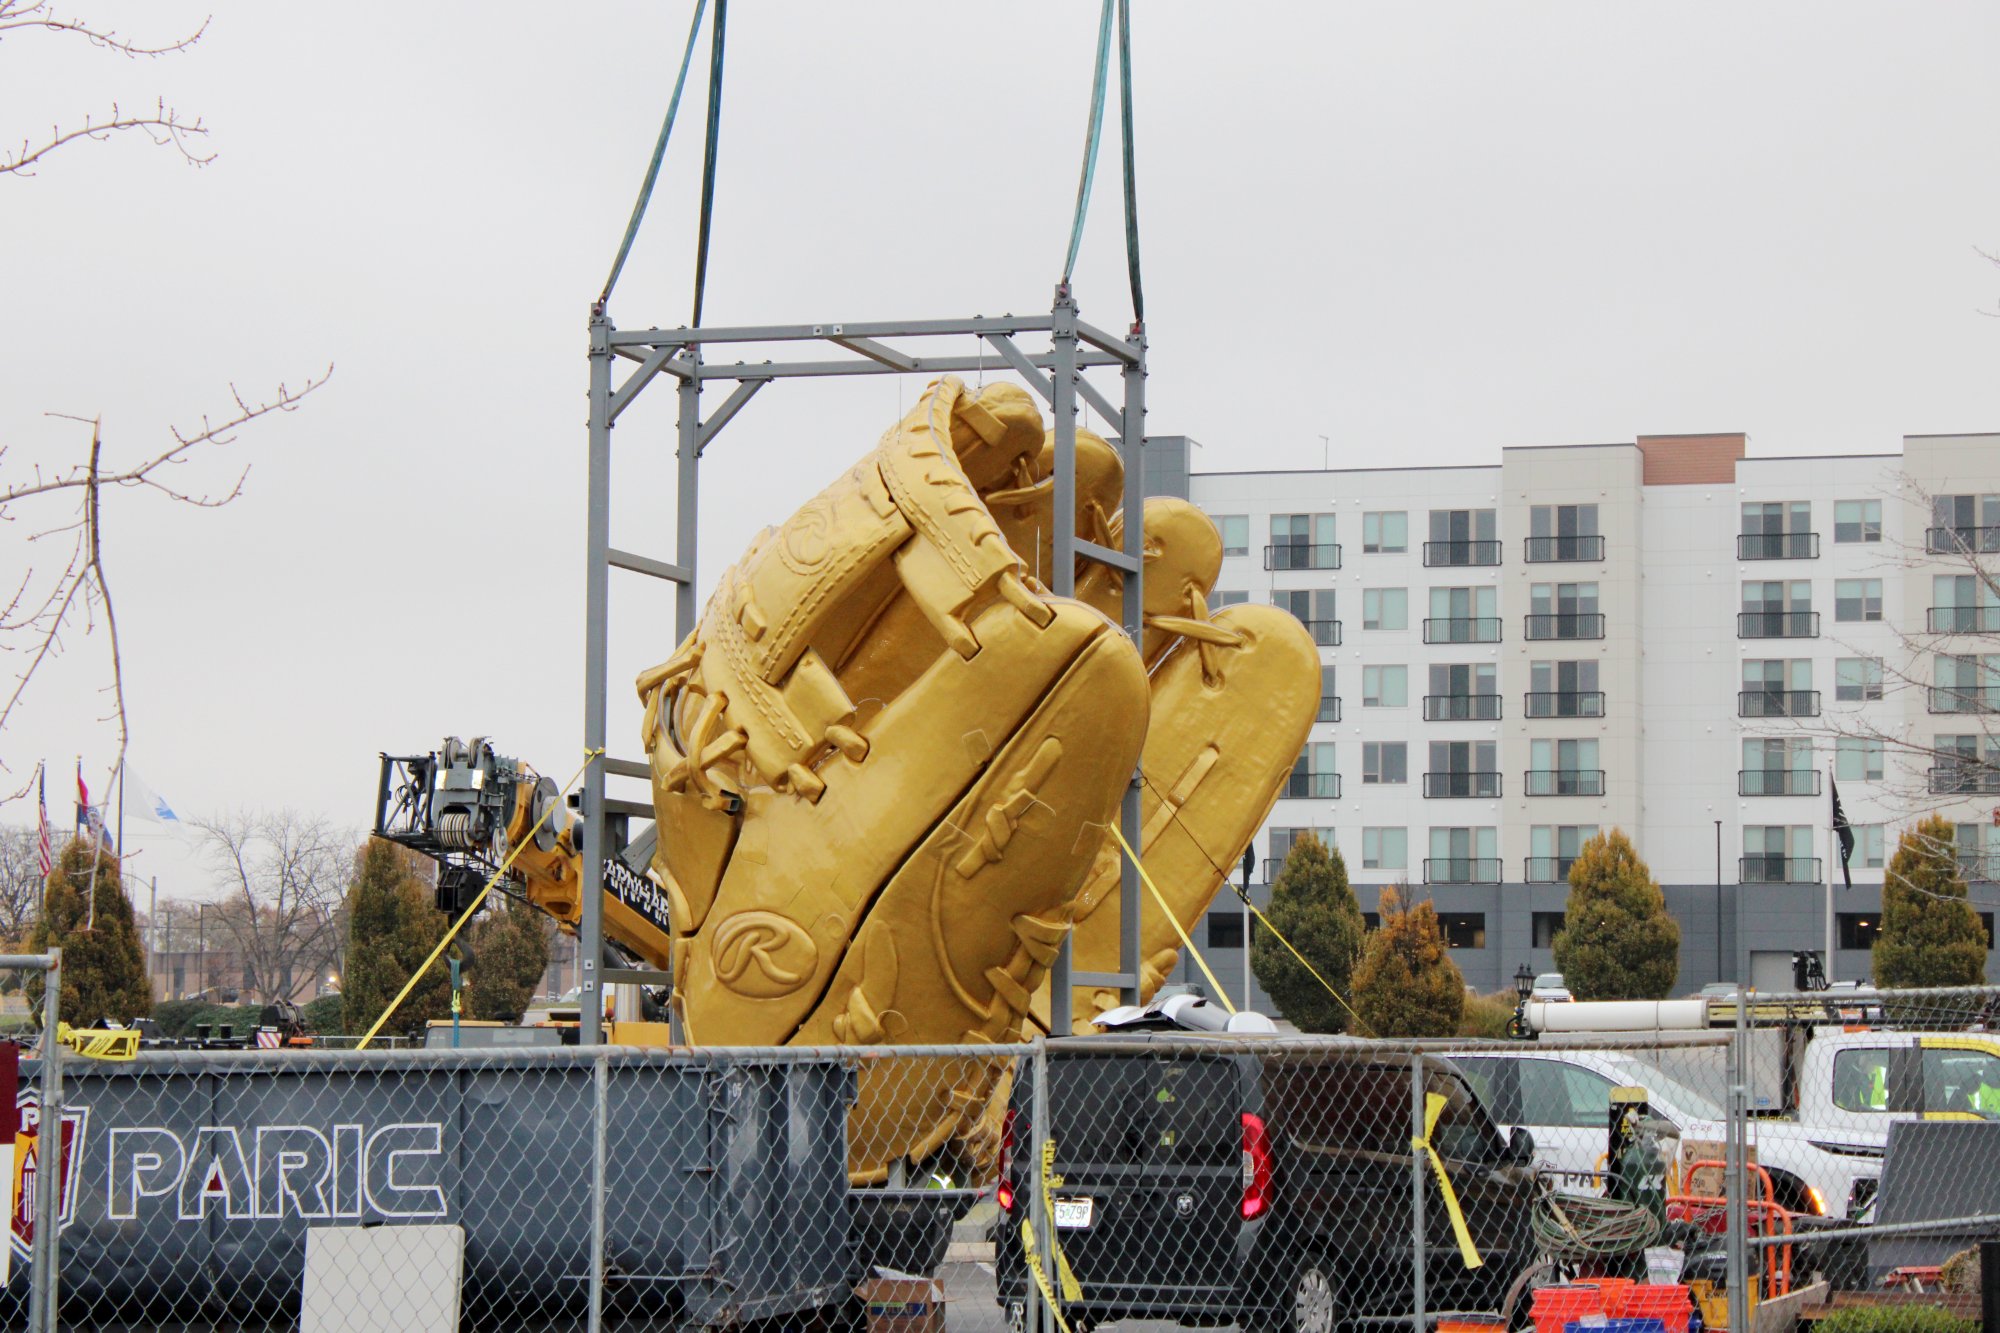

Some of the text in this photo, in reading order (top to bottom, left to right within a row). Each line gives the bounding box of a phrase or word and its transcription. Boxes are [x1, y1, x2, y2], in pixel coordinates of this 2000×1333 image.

[604, 858, 669, 926] ARNHAR
[718, 920, 802, 985] R
[108, 1122, 448, 1220] PARIC
